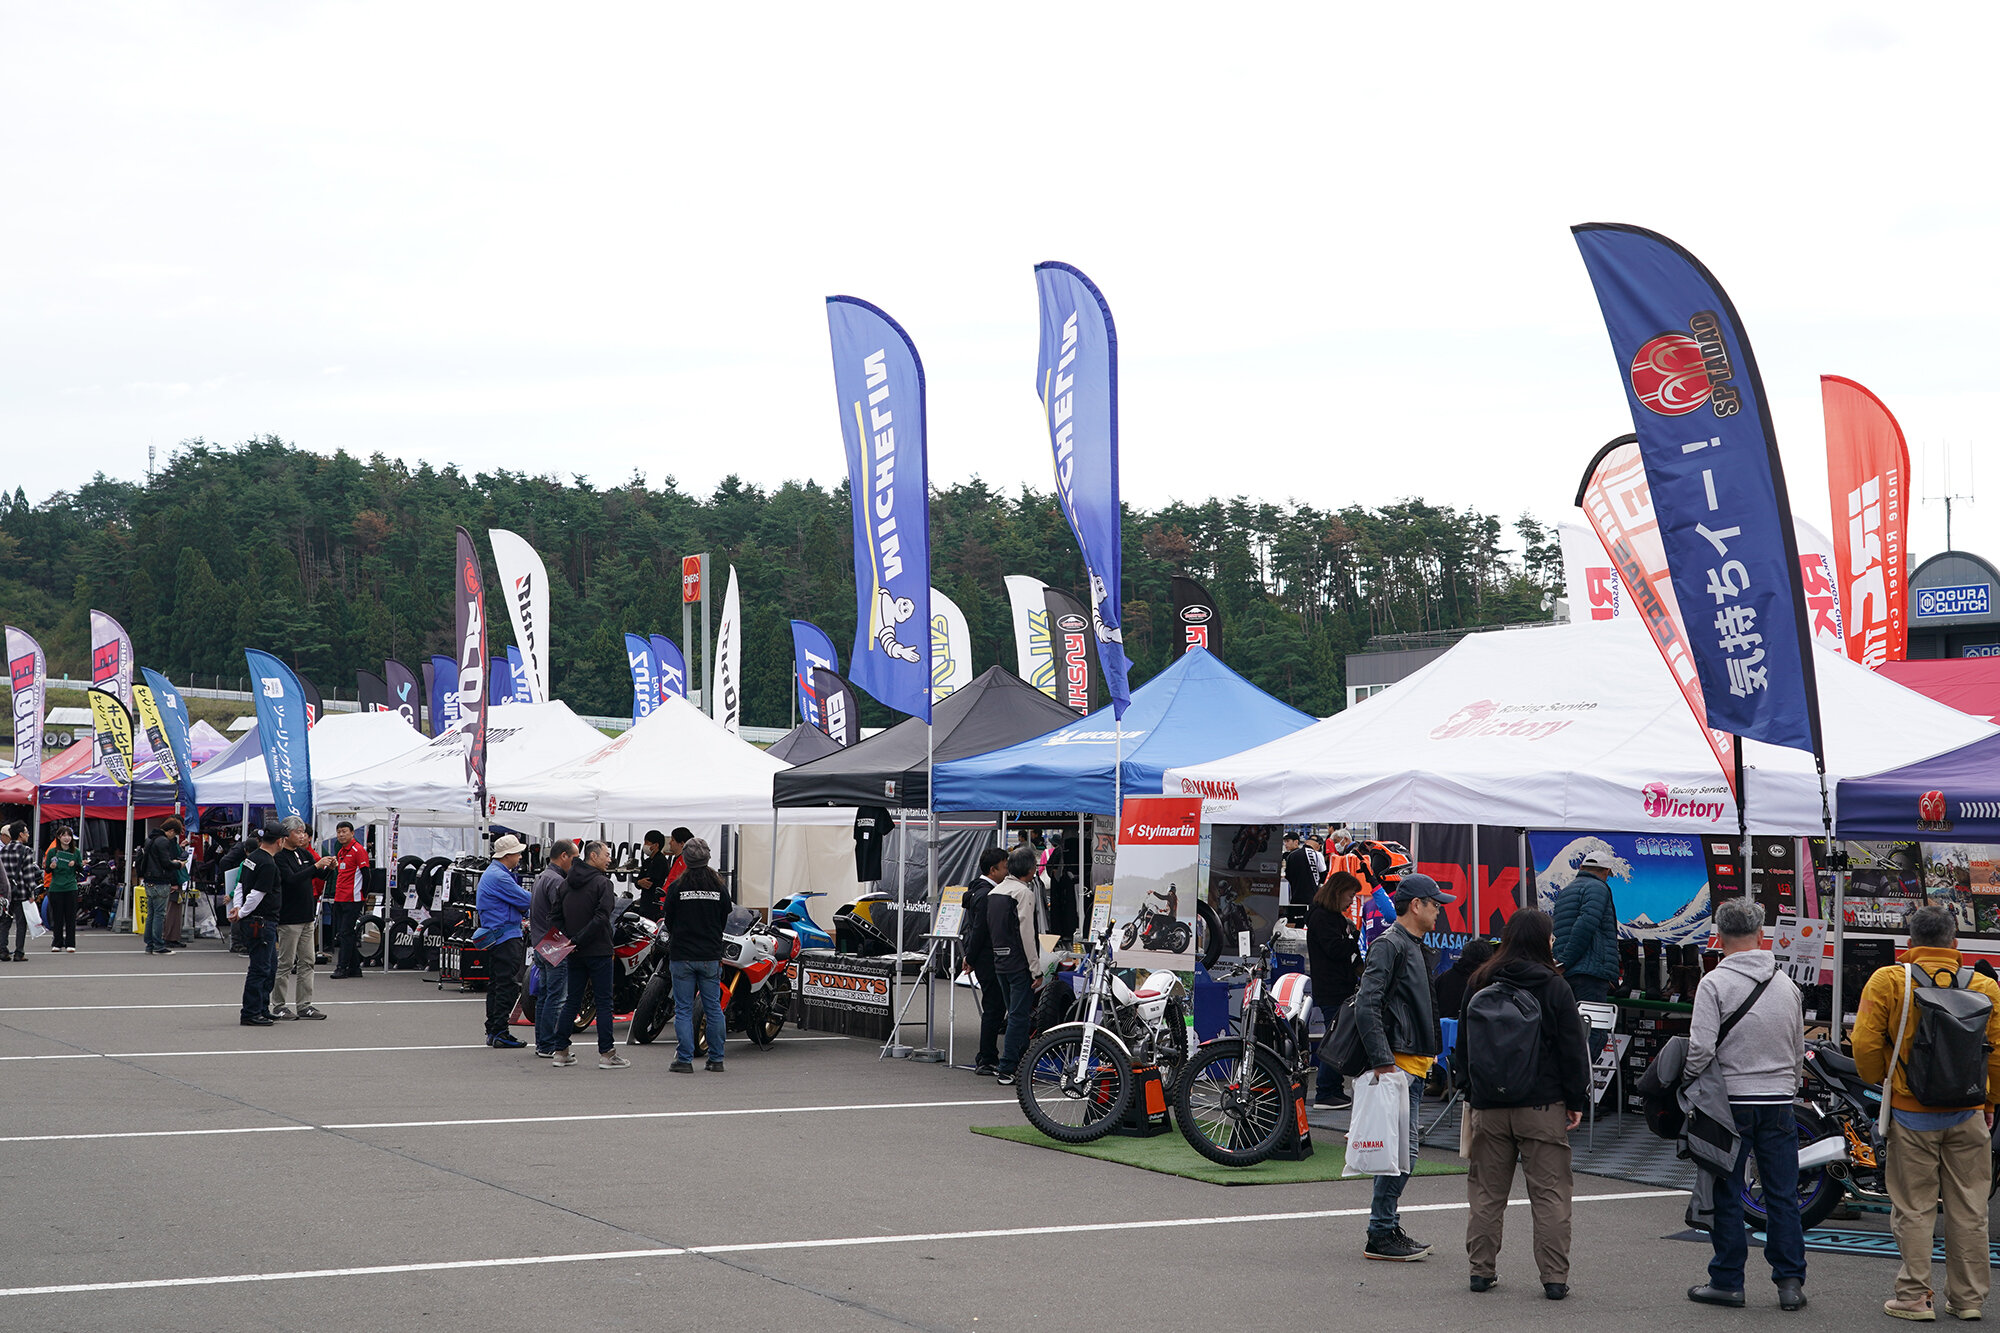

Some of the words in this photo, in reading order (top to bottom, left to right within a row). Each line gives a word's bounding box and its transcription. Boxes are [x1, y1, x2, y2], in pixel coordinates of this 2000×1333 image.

[684, 573, 700, 584] ENEOS
[1936, 589, 1987, 602] OGURA
[1936, 599, 1988, 614] CLUTCH
[1193, 780, 1240, 801] YAMAHA
[1670, 786, 1698, 796] Racing
[1698, 785, 1729, 795] Service
[1661, 797, 1725, 823] Victory
[1137, 824, 1195, 840] Stylmartin
[806, 971, 888, 994] FUNNY'S
[1081, 1035, 1093, 1062] YAMAHA
[1360, 1140, 1384, 1149] YAMAHA
